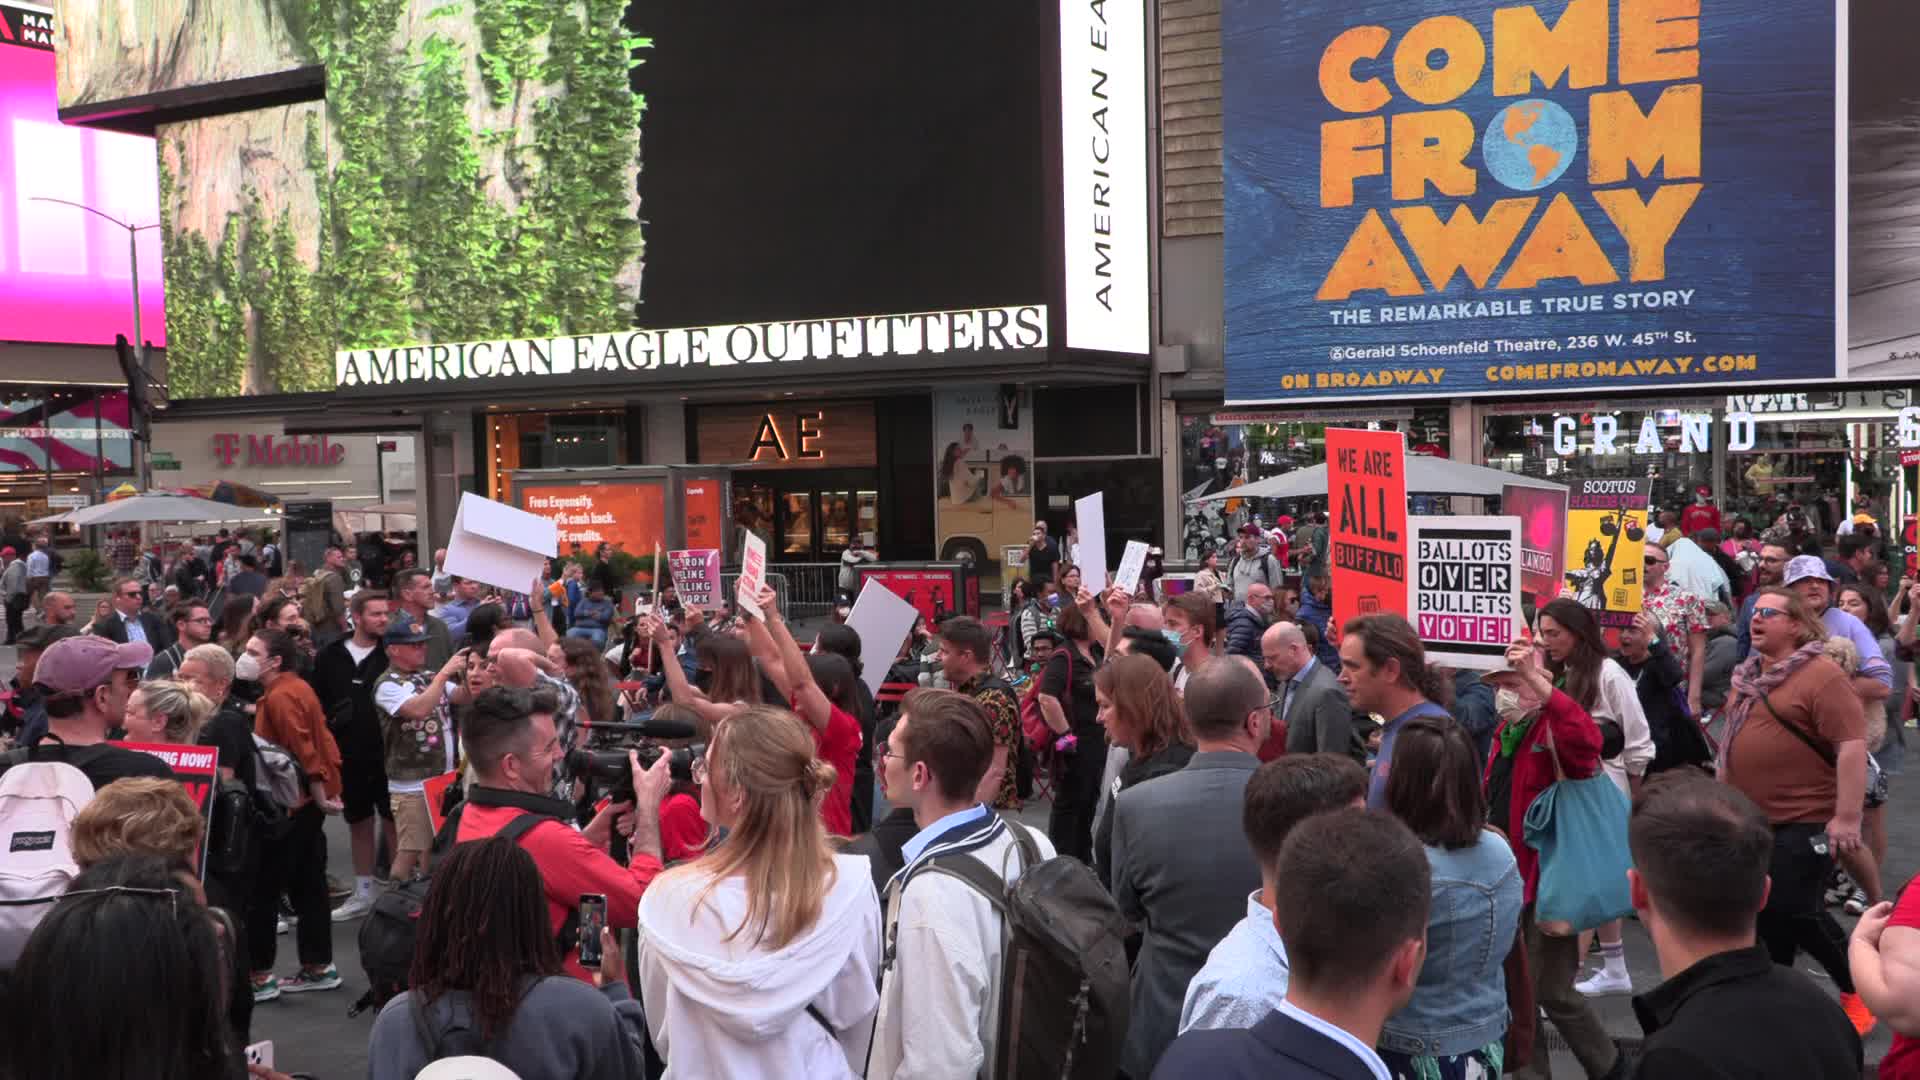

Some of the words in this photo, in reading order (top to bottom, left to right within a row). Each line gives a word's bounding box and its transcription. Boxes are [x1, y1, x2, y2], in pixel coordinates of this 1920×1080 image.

[22, 29, 55, 44] MA
[1318, 0, 1701, 113] COME
[1320, 84, 1703, 208] FROM
[1090, 67, 1112, 312] AMERICAN
[1314, 184, 1704, 301] AWAY
[1330, 309, 1372, 325] THE
[1380, 300, 1533, 323] REMARKABLE
[1542, 295, 1604, 313] TRUE
[1613, 289, 1696, 310] STORY
[338, 338, 553, 386] AMERICAN
[572, 327, 711, 371] EAGLE
[725, 306, 1044, 365] OUTFITTERS
[1345, 345, 1395, 359] Gerald
[1400, 339, 1489, 357] Schoenfeld
[1494, 338, 1562, 352] Theatre,
[1567, 335, 1599, 349] 236
[1604, 333, 1627, 347] W.
[1674, 330, 1697, 344] St.
[1281, 373, 1309, 389] ON
[1316, 367, 1446, 388] BROADWAY
[1486, 354, 1758, 382] COMEFROMAWAY.COM
[748, 411, 824, 461] AE
[1553, 412, 1756, 455] GRAND
[248, 434, 349, 465] Mobile
[1338, 448, 1358, 474] WE
[1363, 448, 1393, 478] ARE
[528, 495, 548, 508] Free
[1583, 480, 1636, 494] SCOTUS
[1340, 484, 1399, 543] ALL
[1336, 542, 1403, 580] BUFFALO
[1418, 541, 1512, 562] BALLOTS
[1521, 551, 1552, 572] LANDO
[1420, 564, 1510, 591] OVER
[1418, 593, 1512, 615] BULLETS
[1420, 616, 1511, 642] VOTE!
[179, 752, 213, 768] NOW!
